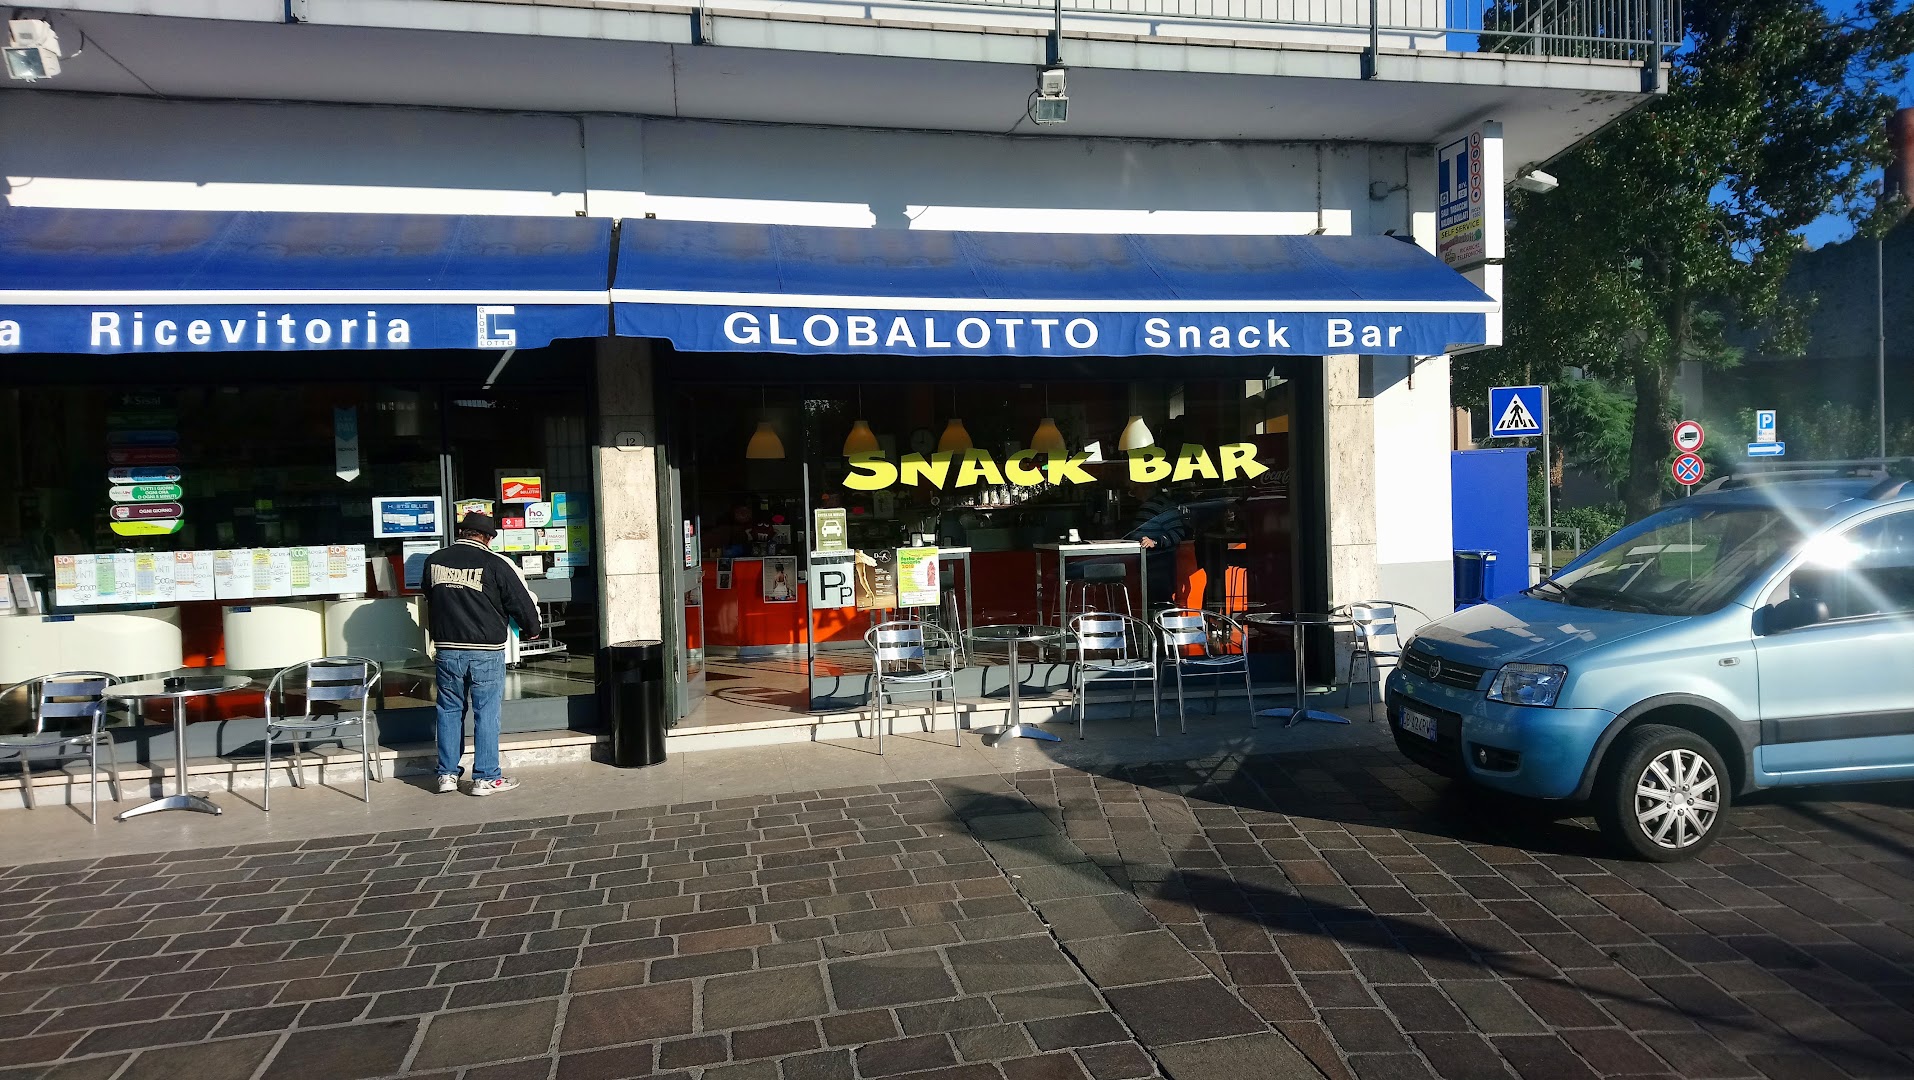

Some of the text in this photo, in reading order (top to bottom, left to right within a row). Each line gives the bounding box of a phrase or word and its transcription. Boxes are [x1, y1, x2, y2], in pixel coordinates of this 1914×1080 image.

[1441, 219, 1480, 239] SELF SERVICE
[90, 311, 410, 346] Ricevitoria
[723, 311, 1403, 349] GLOBALOTTO Snack Bar
[1762, 414, 1772, 428] P
[626, 437, 636, 446] 12
[842, 443, 1270, 491] SNACK BAR
[820, 571, 846, 601] P
